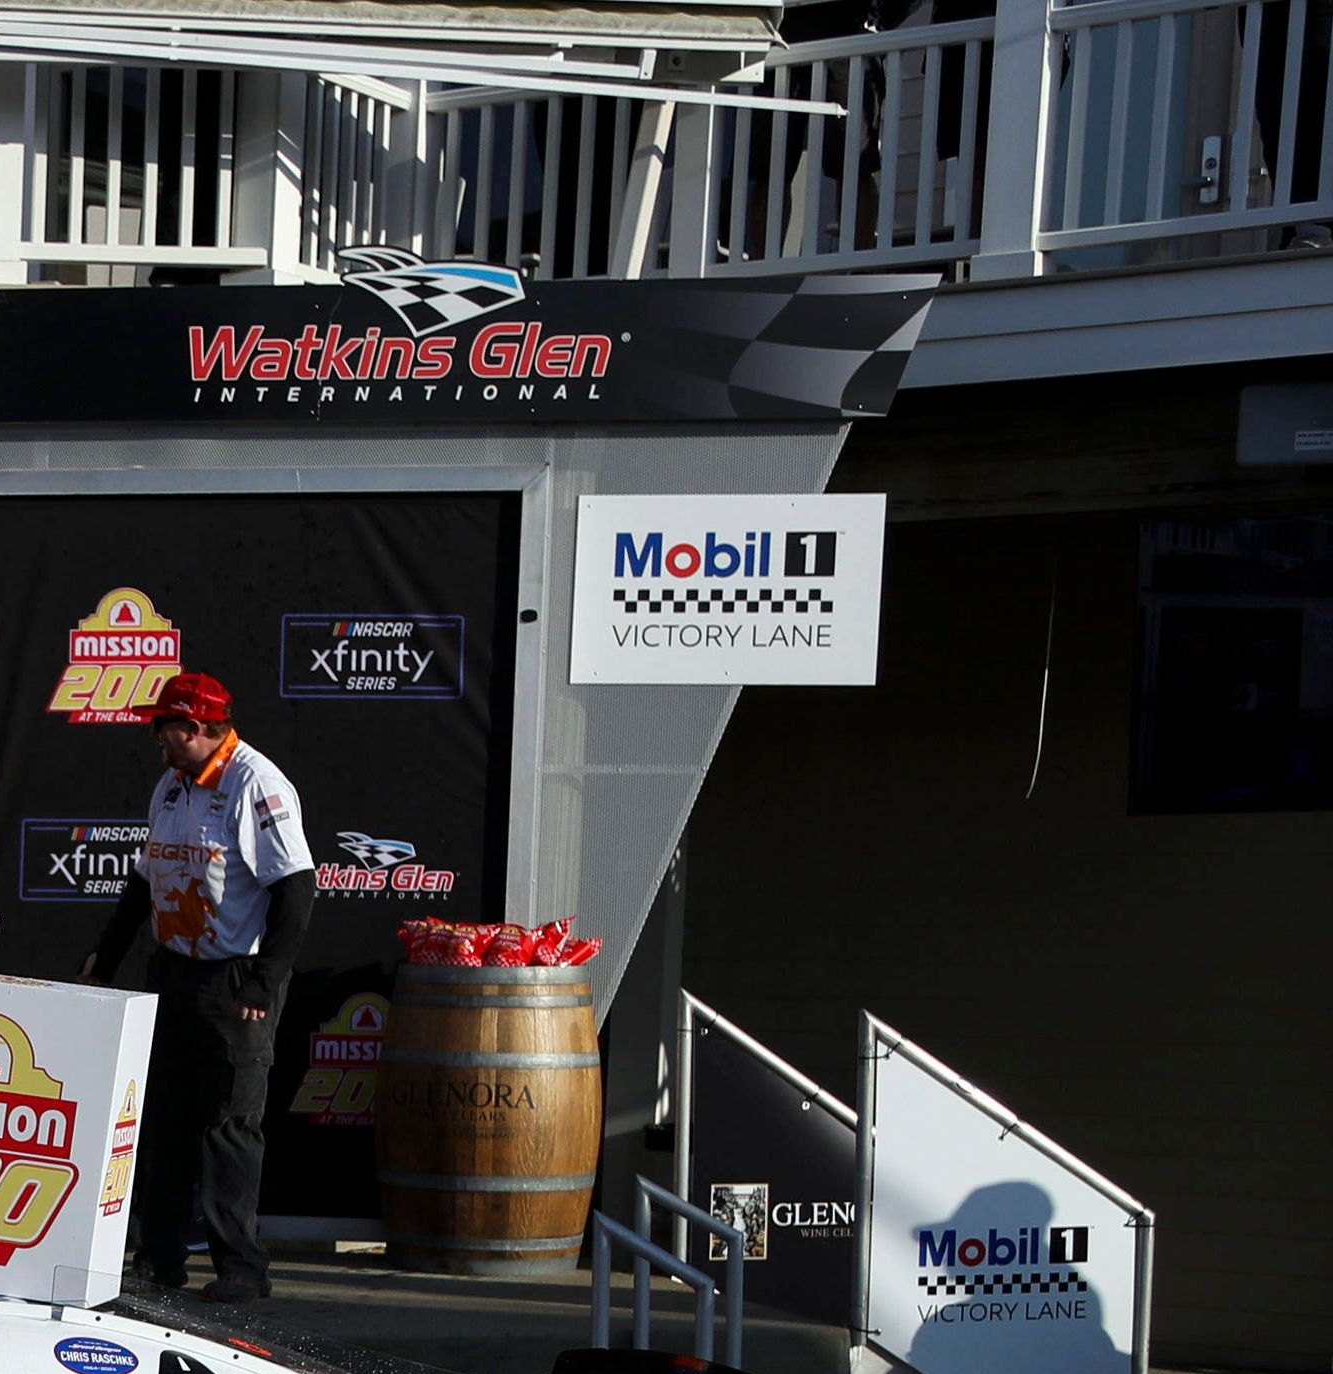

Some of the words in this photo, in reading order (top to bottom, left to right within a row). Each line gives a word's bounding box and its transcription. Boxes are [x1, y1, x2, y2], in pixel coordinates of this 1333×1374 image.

[188, 323, 457, 381] Watkins
[470, 321, 612, 378] Glen
[194, 384, 601, 402] INTERNATIONAL
[614, 531, 770, 578] Mobil
[350, 622, 412, 637] NASCAR
[613, 624, 743, 648] VICTORY
[753, 624, 832, 648] LANE
[75, 636, 175, 657] MISSION
[311, 640, 434, 681] xfinity
[50, 665, 181, 711] 200
[345, 677, 396, 690] SERIES
[78, 711, 91, 722] AT
[93, 711, 113, 722] THE
[89, 826, 149, 841] NASCAR
[84, 880, 127, 894] SERIE
[391, 865, 454, 892] Glen
[315, 1040, 382, 1061] MISSI
[289, 1069, 377, 1114] 20
[390, 1083, 535, 1110] GLENORA
[772, 1202, 855, 1226] GLEN
[801, 1227, 829, 1238] WINE
[918, 1228, 1038, 1267] Mobil
[917, 1302, 1018, 1324] VICTORY
[1025, 1300, 1085, 1320] LANE
[61, 1351, 89, 1363] CHRIS
[91, 1352, 135, 1366] RASCHKE
